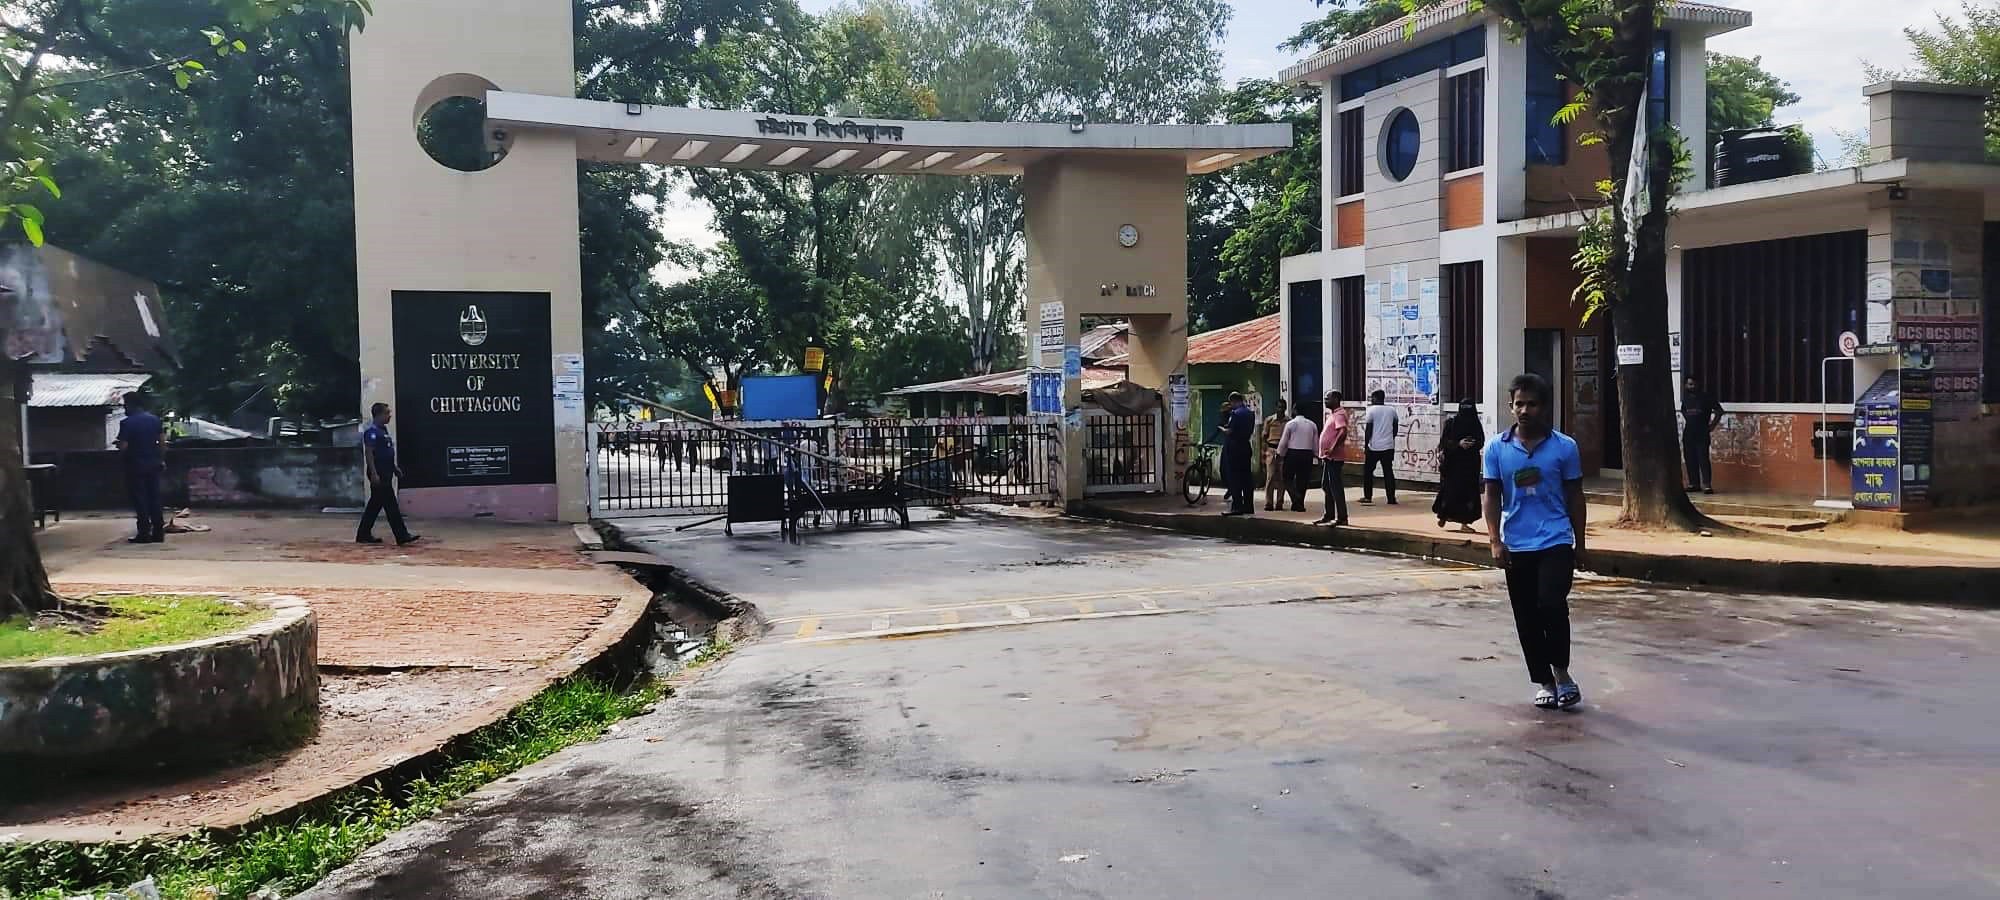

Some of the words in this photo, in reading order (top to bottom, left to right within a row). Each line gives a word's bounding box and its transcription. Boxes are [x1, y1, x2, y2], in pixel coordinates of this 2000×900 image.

[756, 115, 808, 136] চট্টগ্রাম
[1898, 327, 1923, 340] BCS
[1926, 327, 1952, 340] BCS
[1954, 327, 1978, 340] BCS
[431, 353, 521, 370] UNIVERSITY
[466, 375, 486, 391] OF
[1935, 376, 1950, 390] CS
[1954, 376, 1978, 390] BCS
[430, 396, 521, 413] CHITTAGONG
